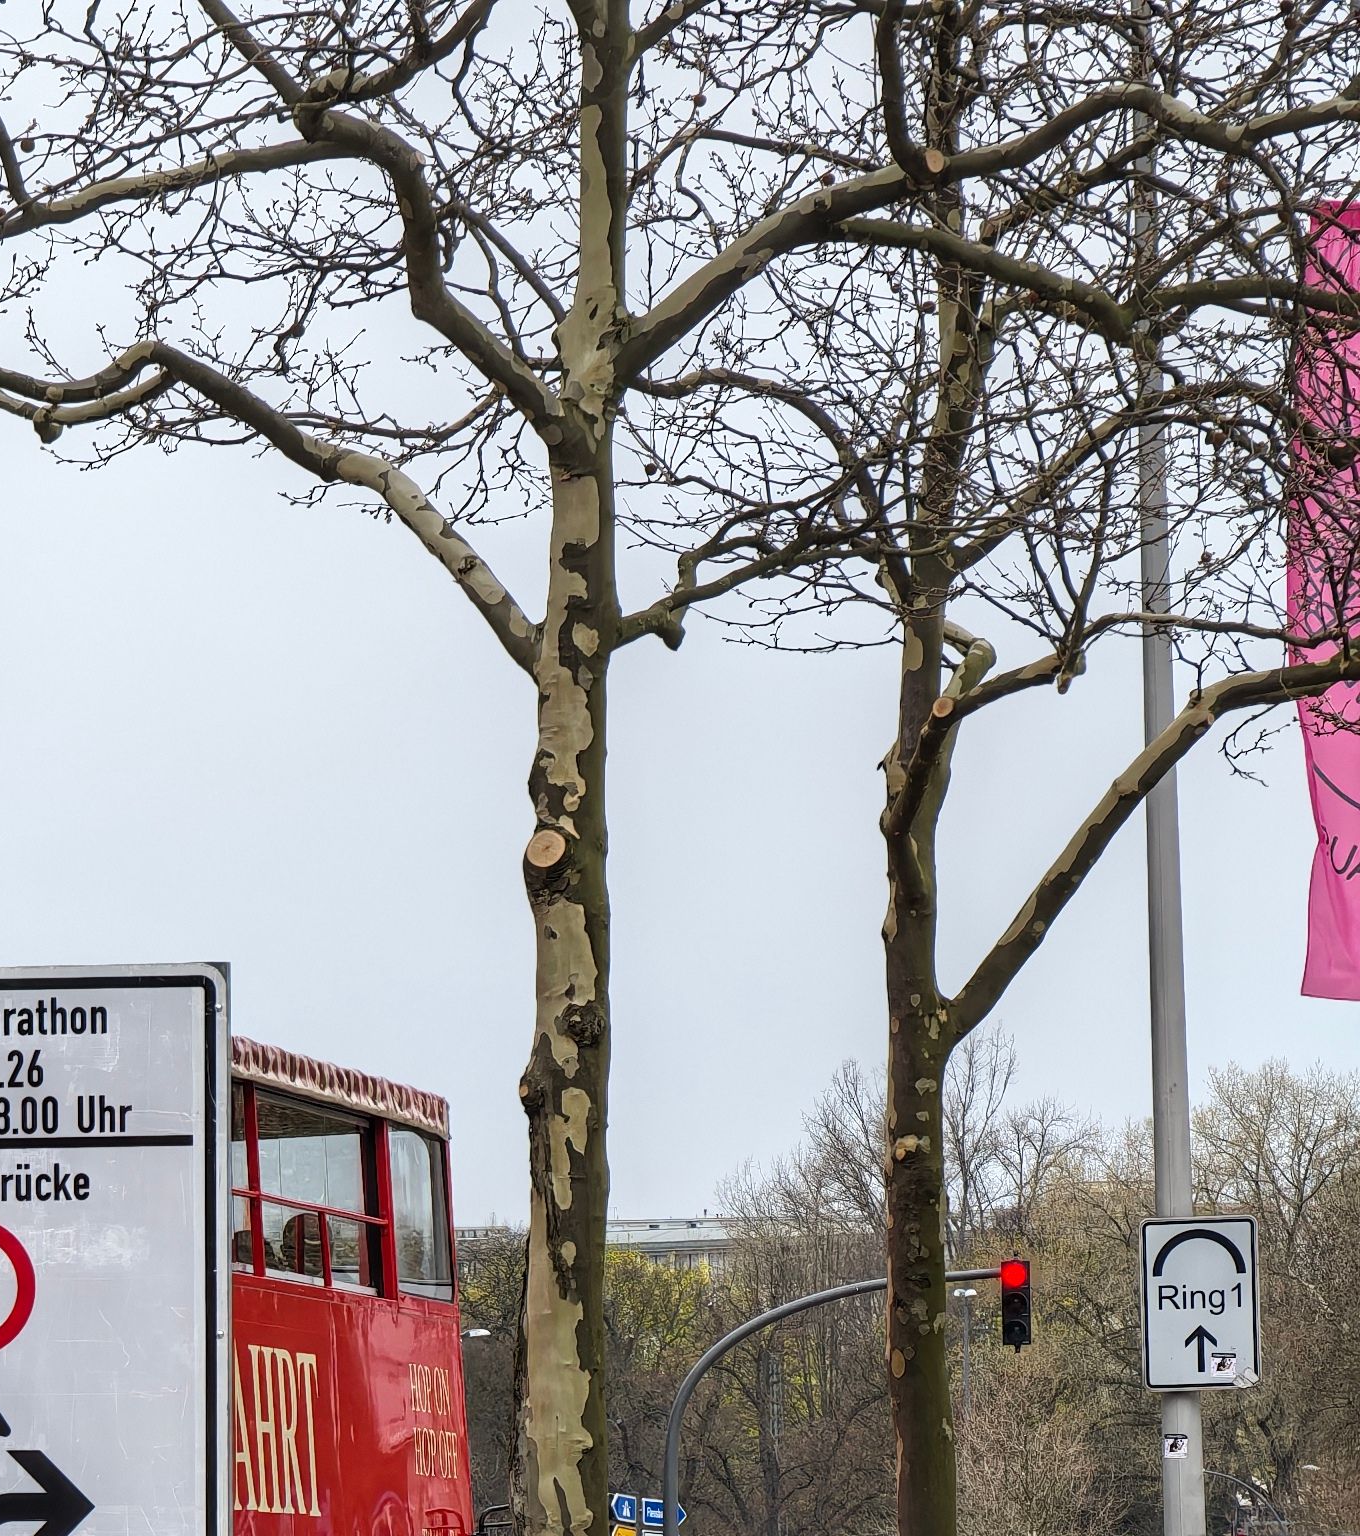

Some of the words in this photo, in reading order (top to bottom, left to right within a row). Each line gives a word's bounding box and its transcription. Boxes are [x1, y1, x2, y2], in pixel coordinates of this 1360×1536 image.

[77, 1095, 132, 1133] Uhr
[408, 1363, 432, 1414] HOP
[433, 1366, 451, 1417] ON
[413, 1427, 437, 1478] HOP
[439, 1430, 458, 1480] OFF
